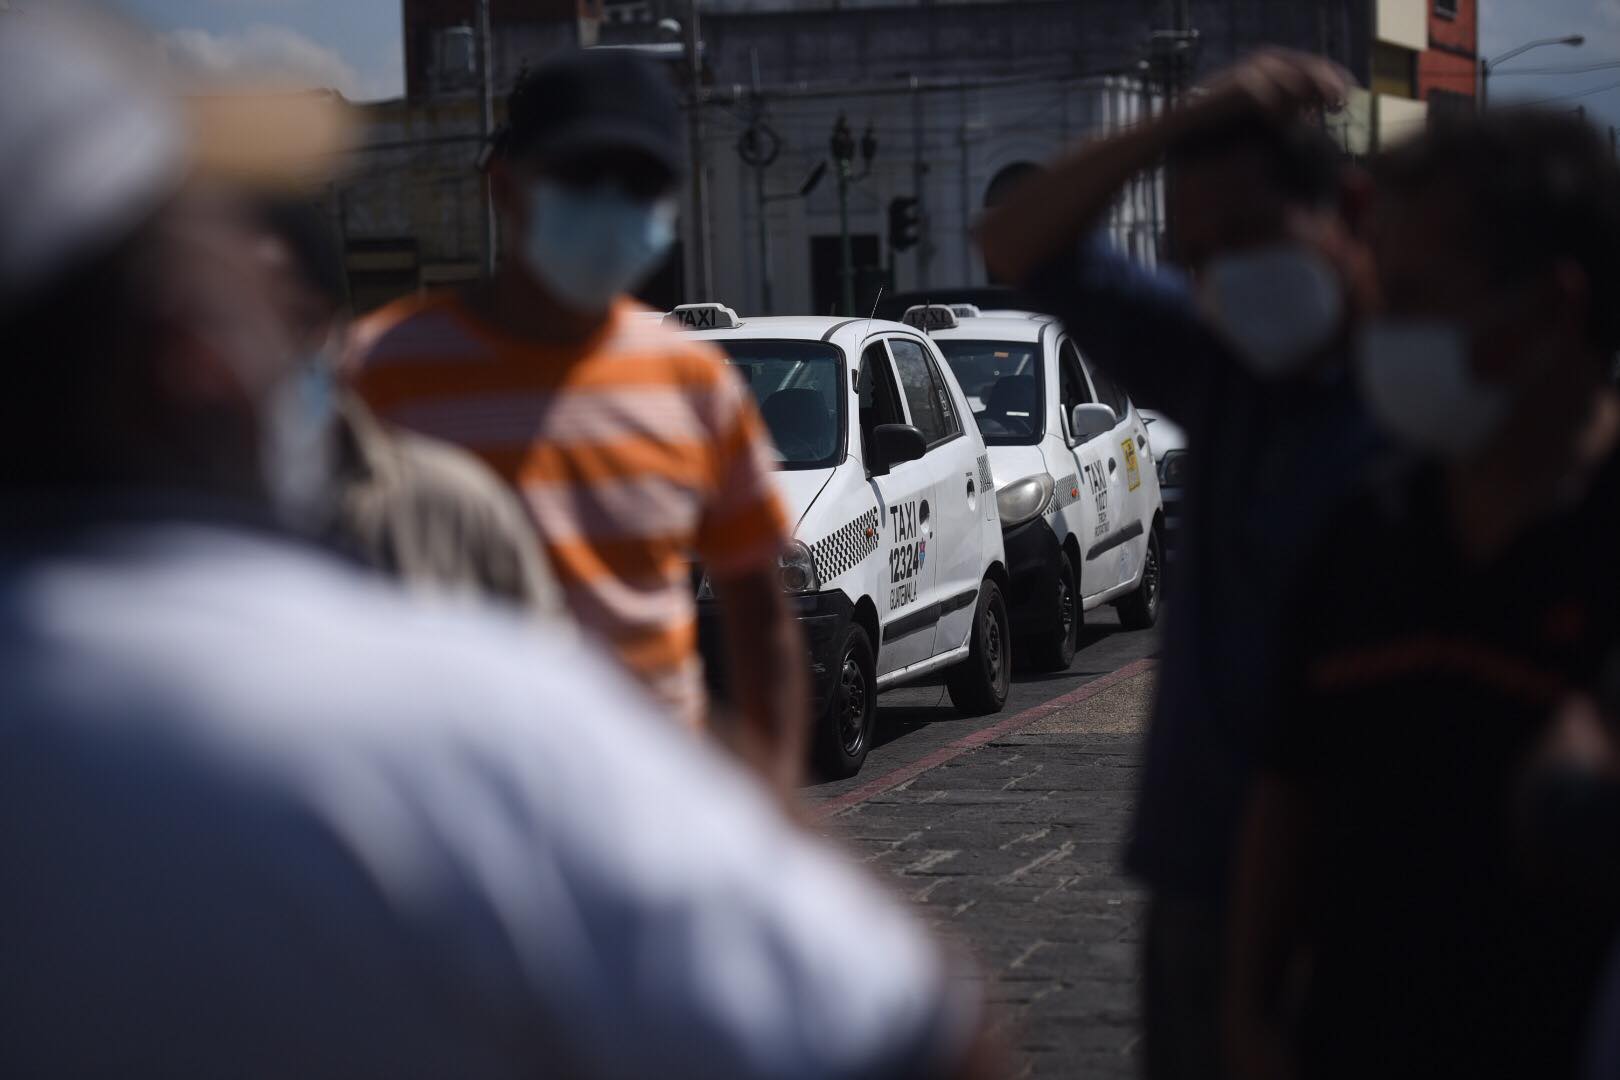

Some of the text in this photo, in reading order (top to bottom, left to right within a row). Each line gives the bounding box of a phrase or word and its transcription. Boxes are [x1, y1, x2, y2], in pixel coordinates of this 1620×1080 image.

[676, 308, 716, 327] TAXI
[1084, 459, 1107, 495] TAXI
[890, 501, 917, 543] TAXI
[889, 541, 919, 584] 12324
